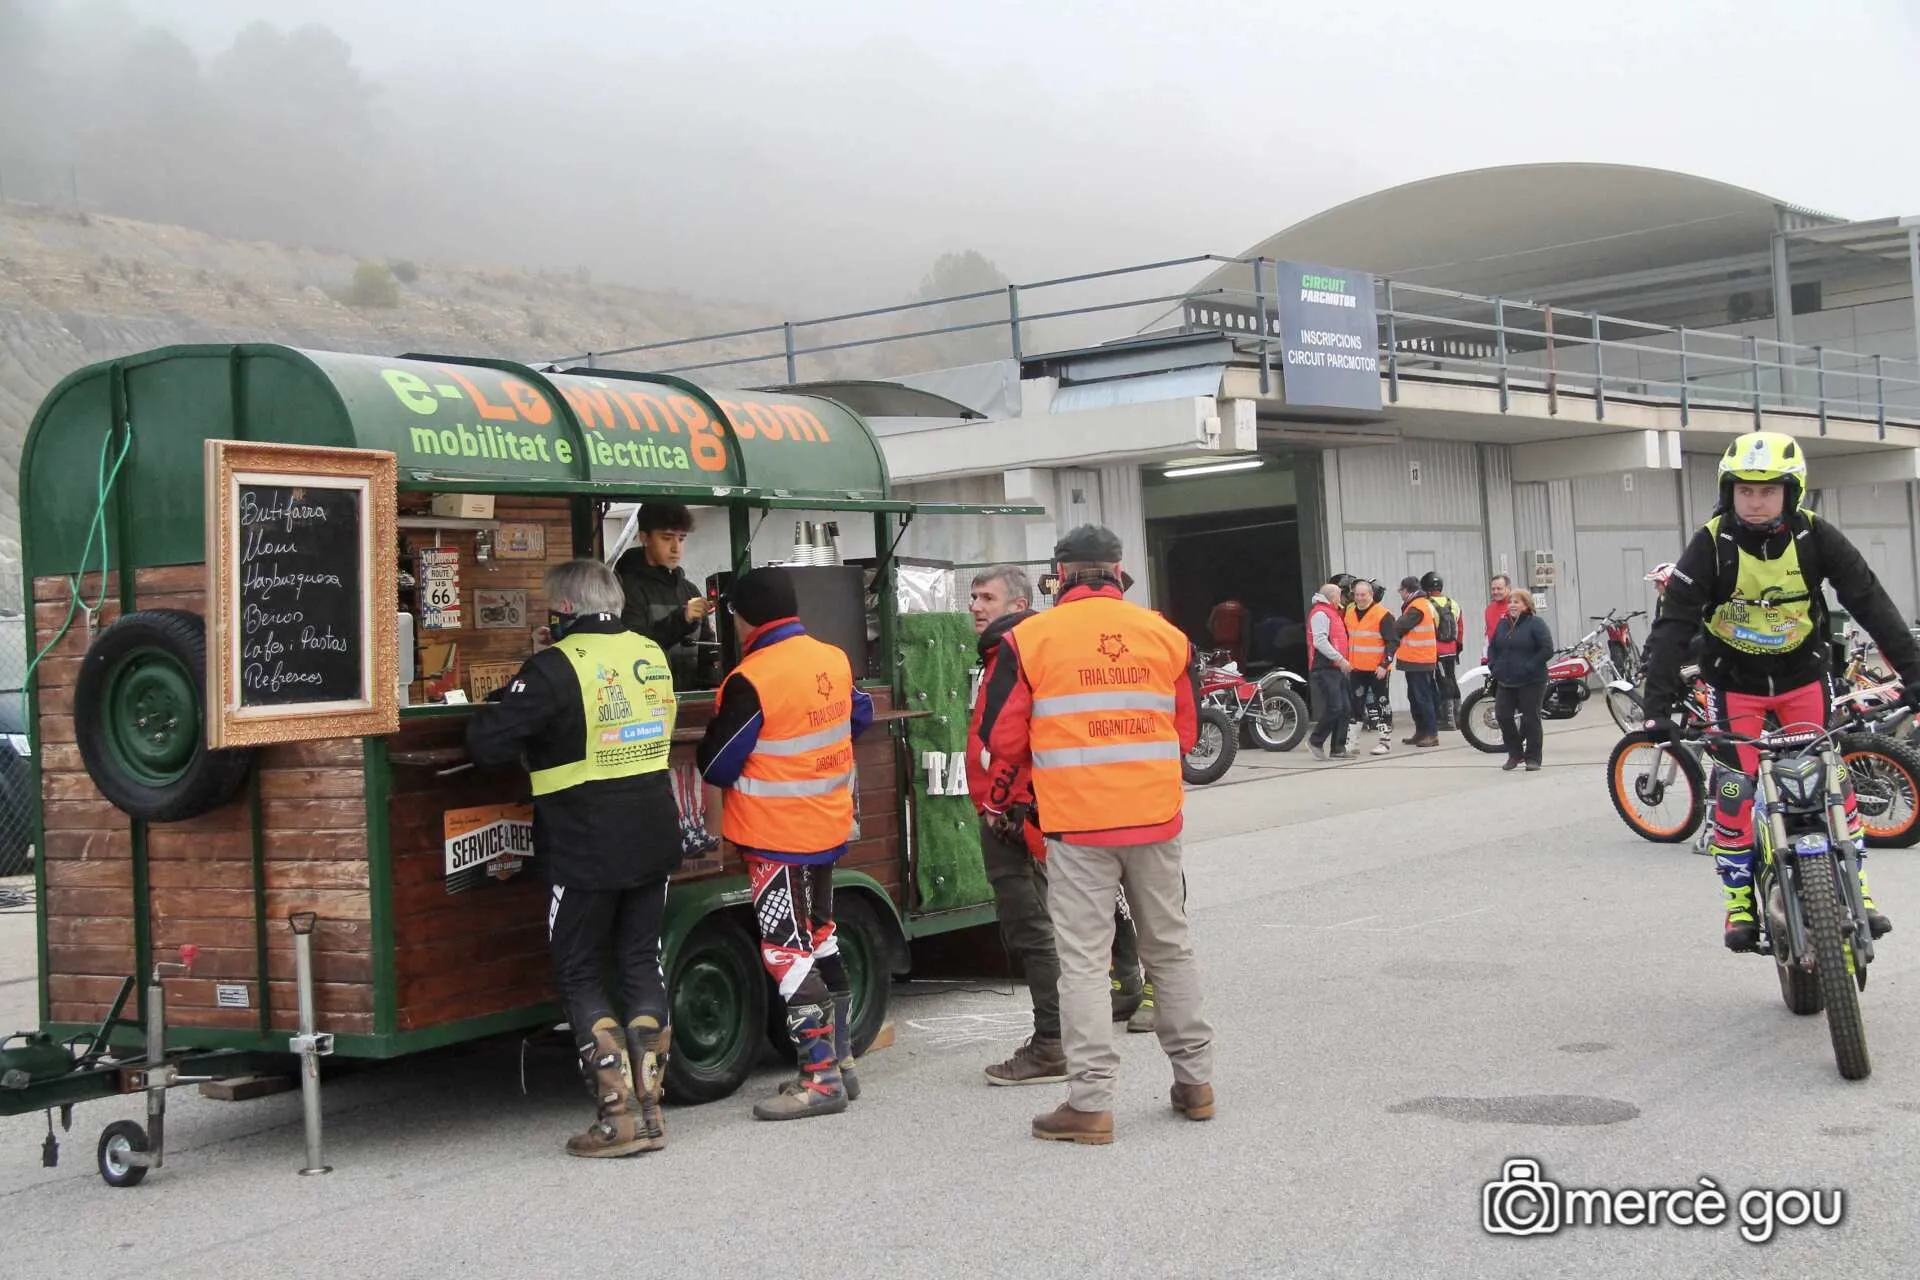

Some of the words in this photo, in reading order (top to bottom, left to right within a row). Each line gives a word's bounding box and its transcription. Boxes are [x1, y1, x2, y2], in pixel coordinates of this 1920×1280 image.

[1301, 274, 1346, 293] CIRCUIT
[1300, 288, 1356, 308] PARCMOTOR
[1301, 329, 1362, 350] INSCRIPCIONS
[1288, 349, 1326, 367] CIRCUIT
[1326, 353, 1376, 372] PARCMOTOR
[410, 423, 551, 463] mobilitat
[431, 569, 450, 578] ROUTE
[431, 588, 450, 605] 66
[244, 660, 323, 692] Refrescos
[1770, 733, 1817, 745] RENTHAL
[452, 824, 504, 869] SERVICE
